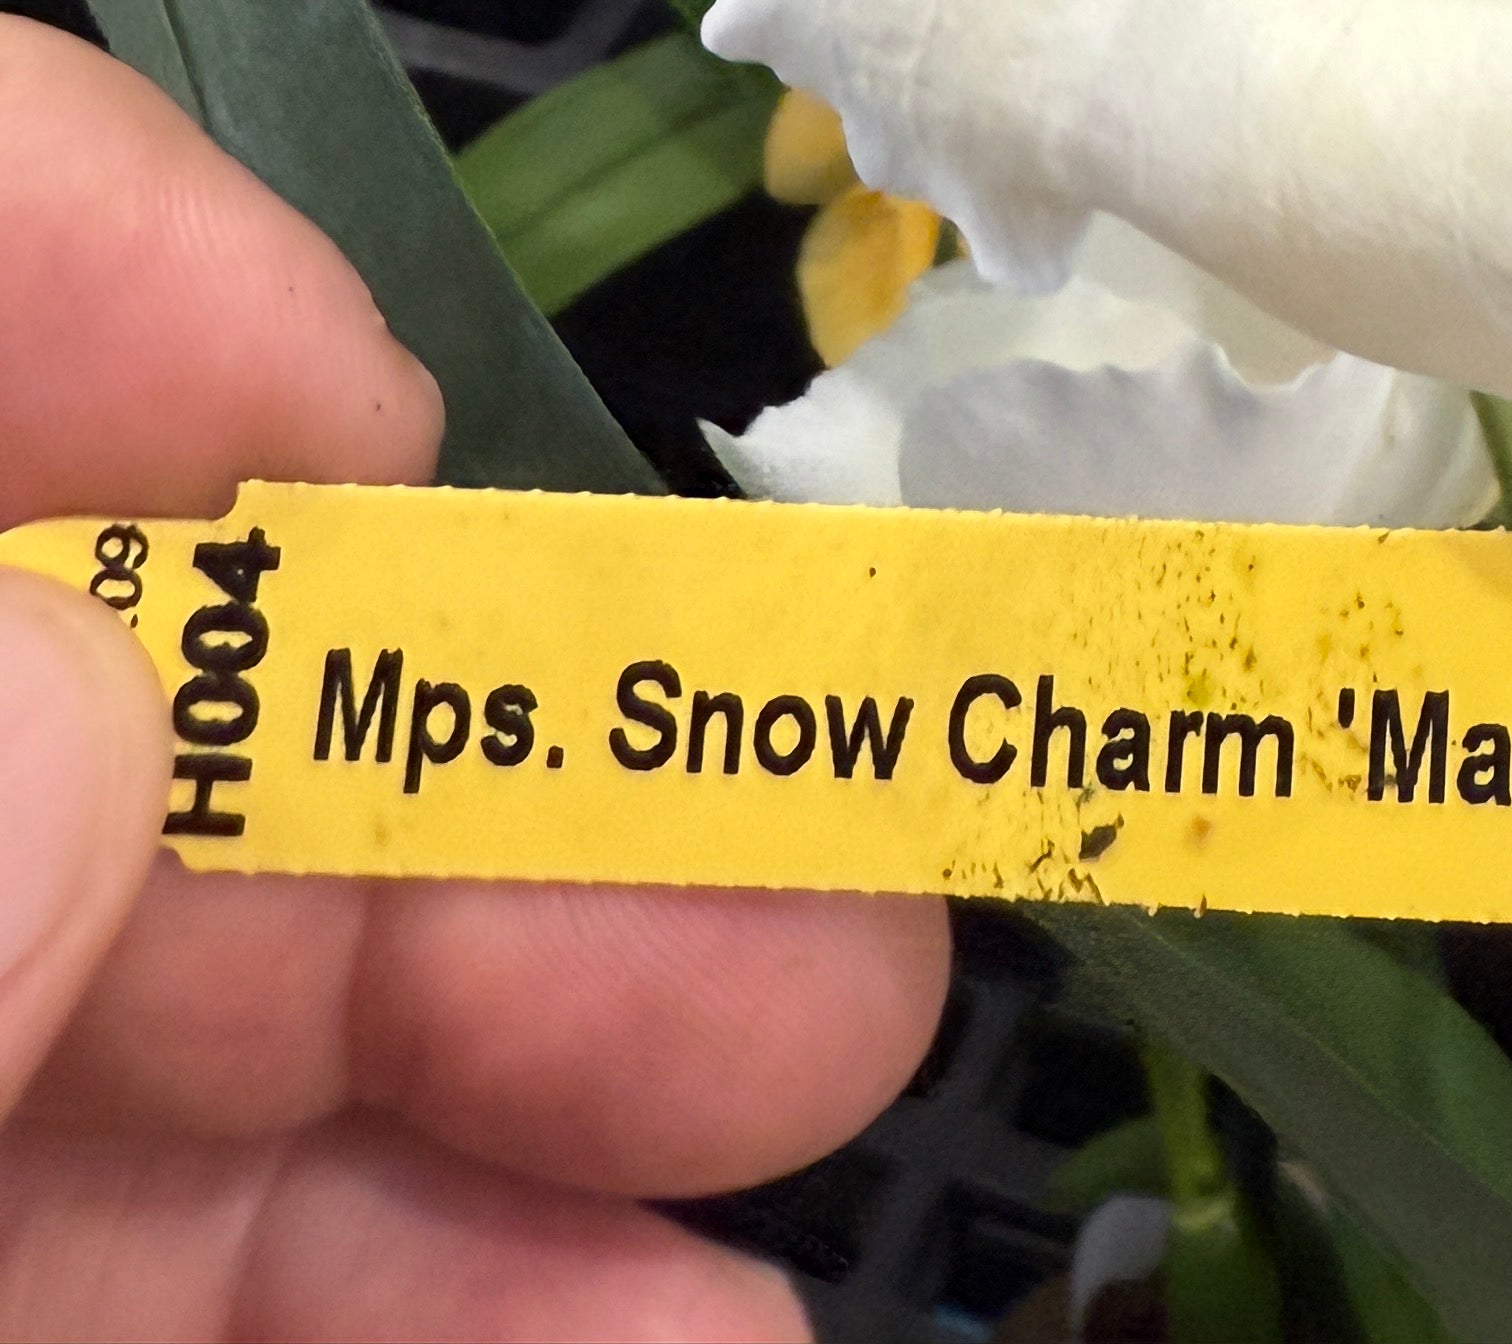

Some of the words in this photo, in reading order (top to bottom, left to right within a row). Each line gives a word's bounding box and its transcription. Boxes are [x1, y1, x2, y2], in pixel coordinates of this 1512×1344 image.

[162, 525, 282, 837] H004
[312, 646, 564, 794] Mps.
[607, 658, 916, 781] Snow
[947, 672, 1296, 799] Charm
